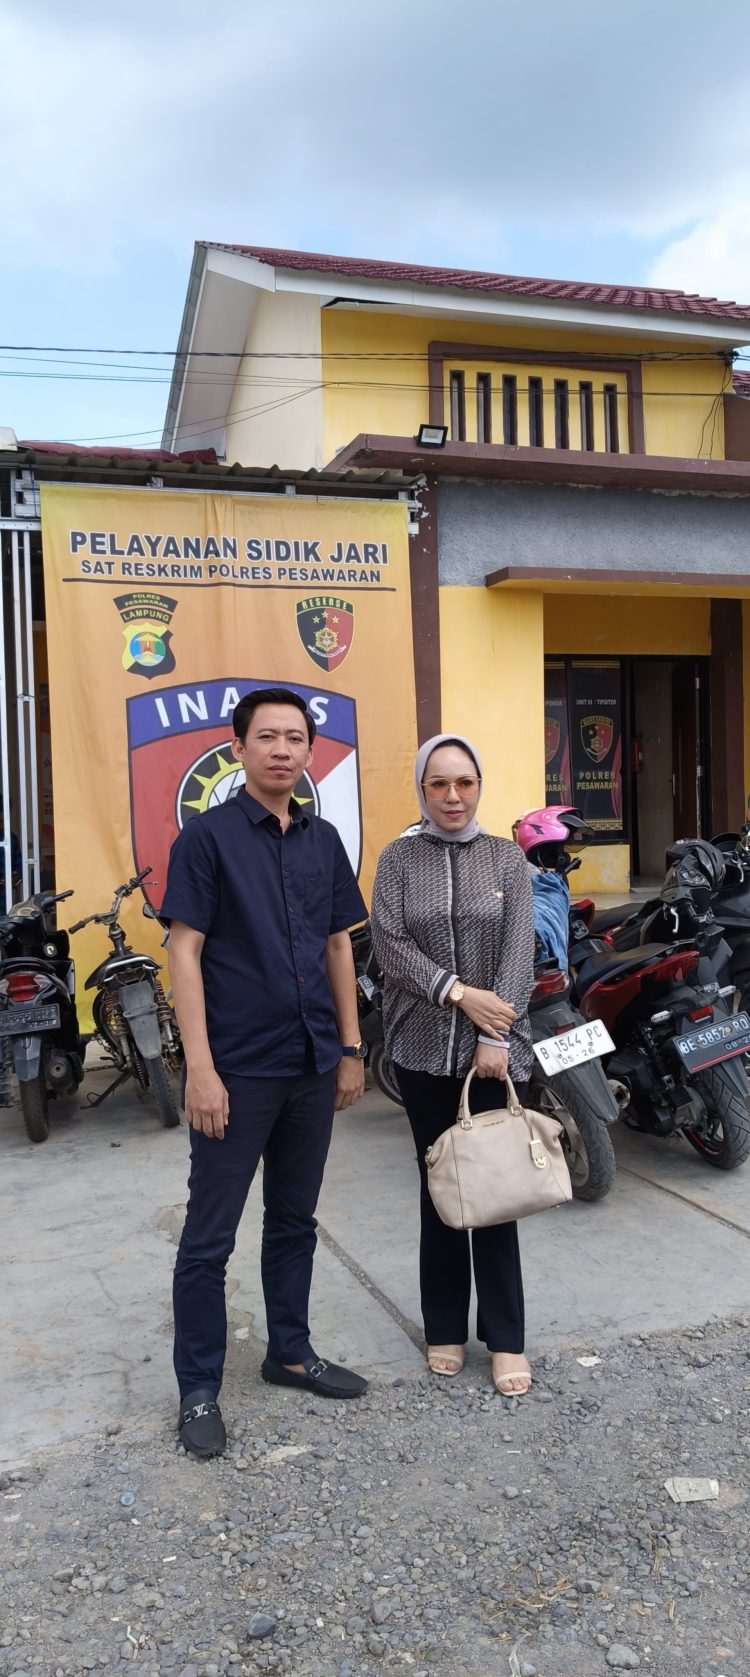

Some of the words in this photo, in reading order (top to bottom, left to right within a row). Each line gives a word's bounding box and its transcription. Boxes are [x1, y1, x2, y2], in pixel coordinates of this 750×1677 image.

[70, 531, 238, 560] PELAYANAN
[246, 538, 322, 563] SIDIK
[329, 541, 389, 565] JARI
[81, 559, 115, 576] SAT
[121, 561, 203, 579] RESKRIM
[208, 563, 273, 580] POLRES
[277, 566, 381, 583] PESAWARAN
[301, 597, 348, 610] RESERSE
[123, 609, 170, 622] LAMPUNG
[154, 686, 330, 728] INAS
[546, 773, 564, 782] RES
[578, 771, 616, 780] POLRES
[576, 781, 618, 791] PESAWARAN
[540, 1047, 550, 1060] B
[554, 1032, 581, 1053] 1544
[585, 1025, 602, 1041] PC
[680, 1038, 698, 1055] BE
[697, 1026, 727, 1046] 5852
